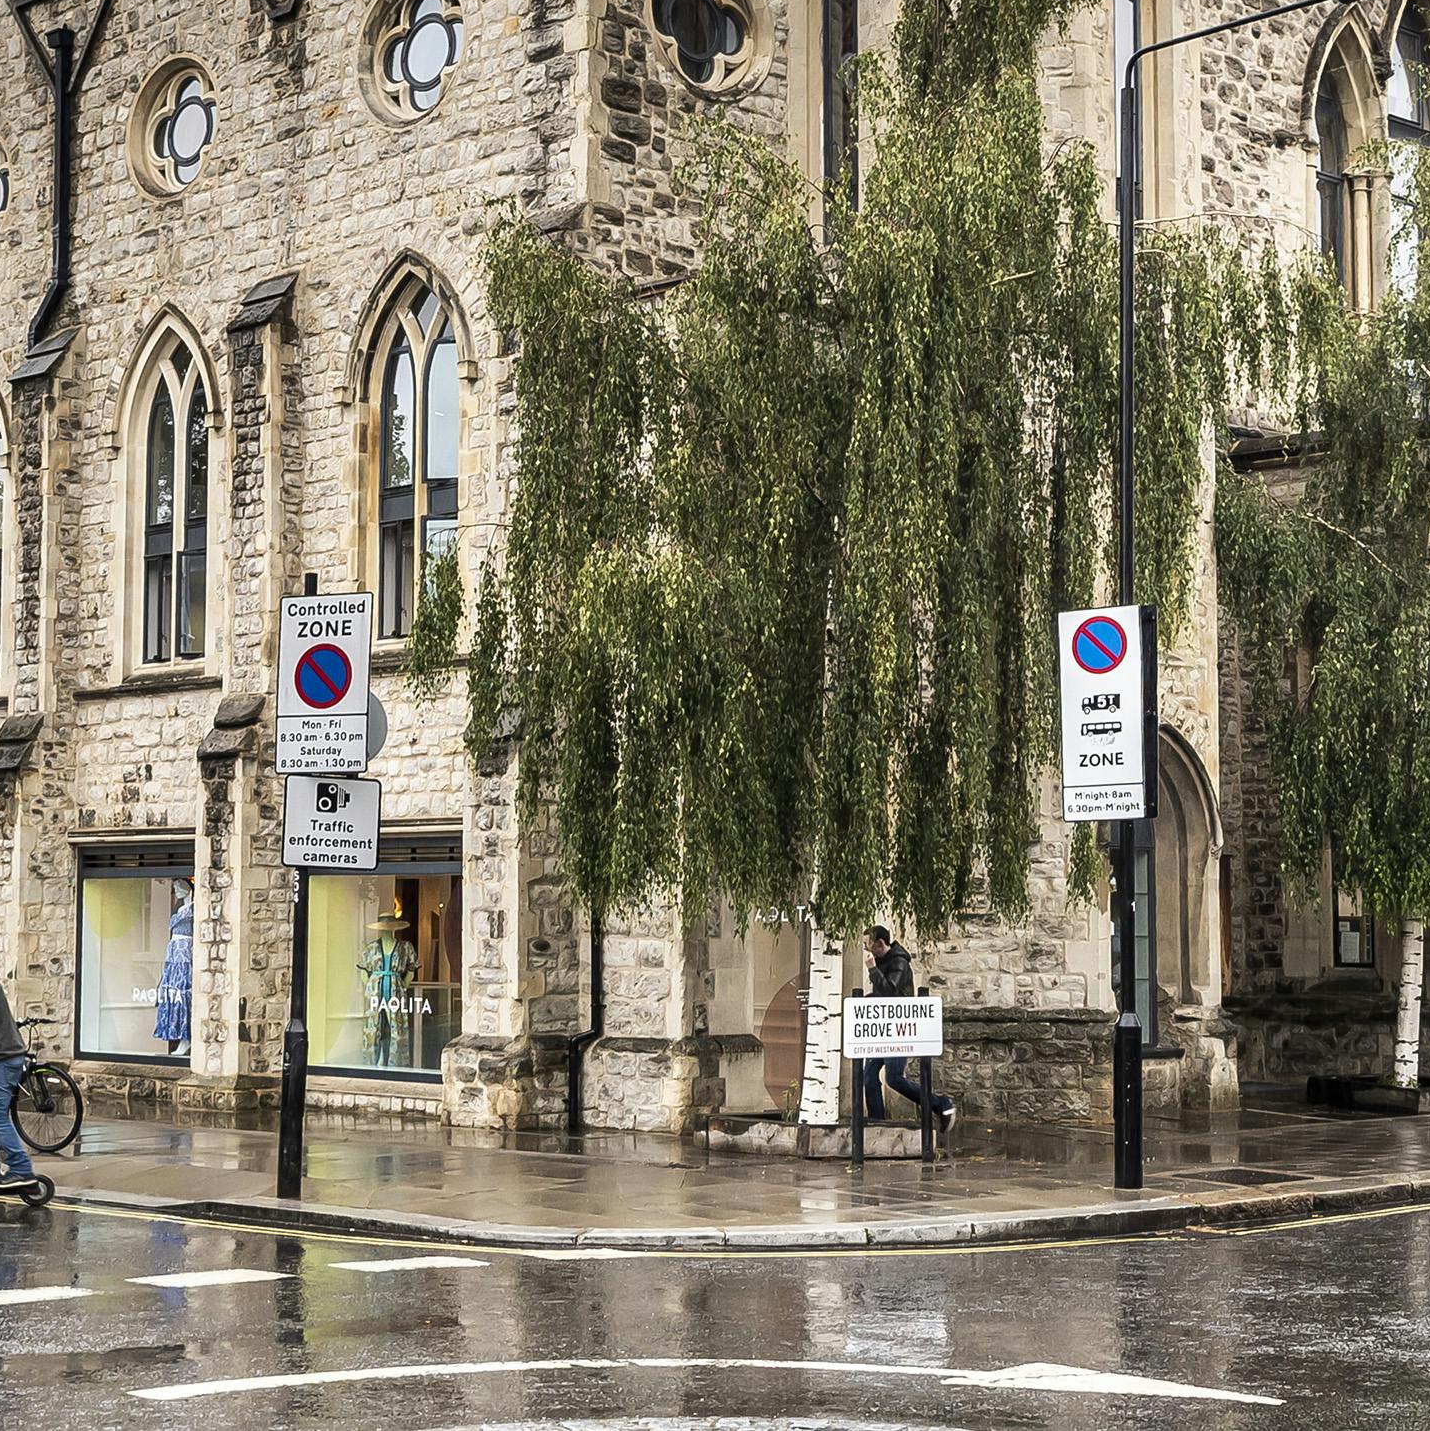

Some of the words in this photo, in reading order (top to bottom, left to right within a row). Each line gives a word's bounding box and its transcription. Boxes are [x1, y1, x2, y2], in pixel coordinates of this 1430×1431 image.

[287, 600, 366, 617] Controlled
[297, 620, 352, 638] ZONE
[1097, 695, 1116, 708] 5T
[302, 721, 322, 730] Mon
[329, 720, 342, 729] Fri
[280, 733, 303, 742] 8.30
[324, 732, 347, 741] 6.30
[349, 734, 363, 743] pm
[300, 746, 342, 756] Saturday
[280, 759, 303, 768] 8.30
[325, 758, 346, 768] 1.30
[347, 760, 362, 769] pm
[1079, 752, 1124, 767] ZONE
[310, 819, 354, 833] Traffic
[288, 834, 373, 849] enforcement
[302, 852, 358, 864] cameras
[132, 987, 183, 1004] PAOLITA
[370, 996, 432, 1014] PAOLITA
[854, 1004, 935, 1019] WESTBOURNE
[854, 1022, 892, 1037] GROVE
[895, 1022, 917, 1037] W11
[854, 1046, 866, 1054] CITY
[875, 1045, 914, 1053] WESTMINSTER
